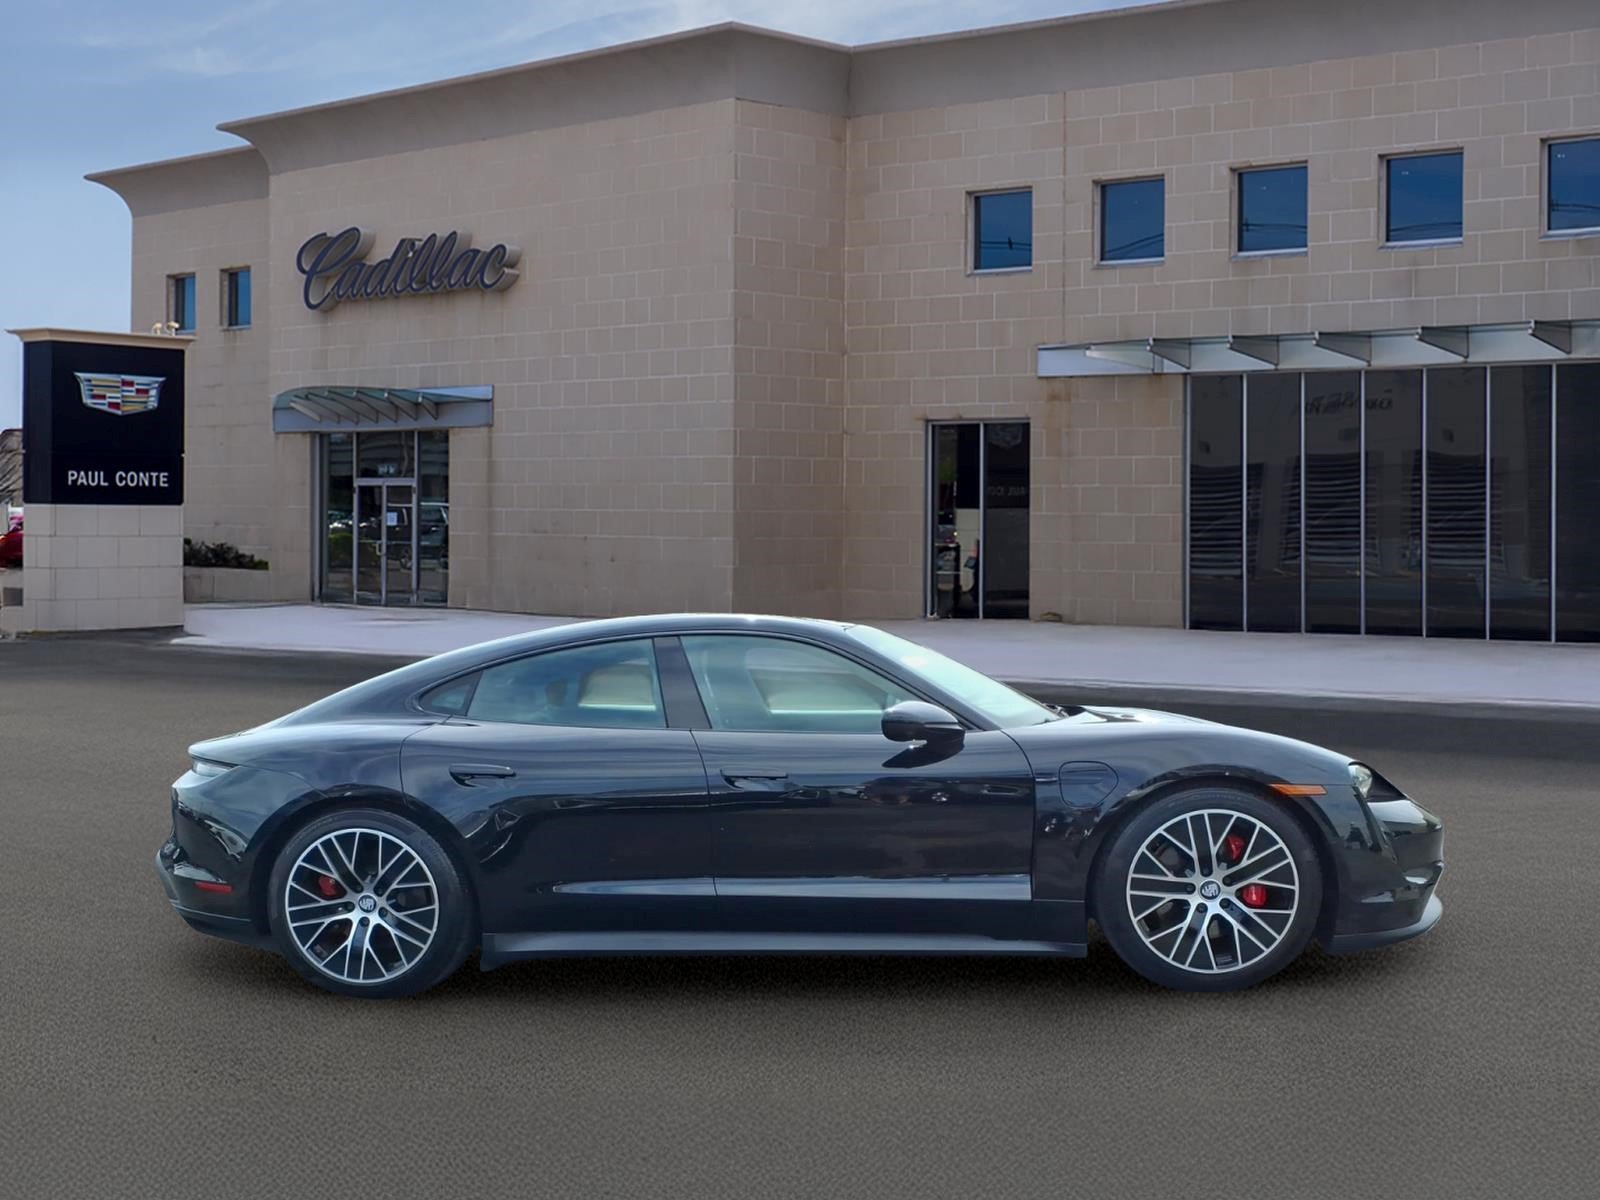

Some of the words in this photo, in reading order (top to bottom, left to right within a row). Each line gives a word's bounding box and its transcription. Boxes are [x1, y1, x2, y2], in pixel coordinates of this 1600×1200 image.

[296, 226, 519, 312] Cadillac
[67, 470, 109, 486] PAUL
[115, 471, 169, 487] CONTE
